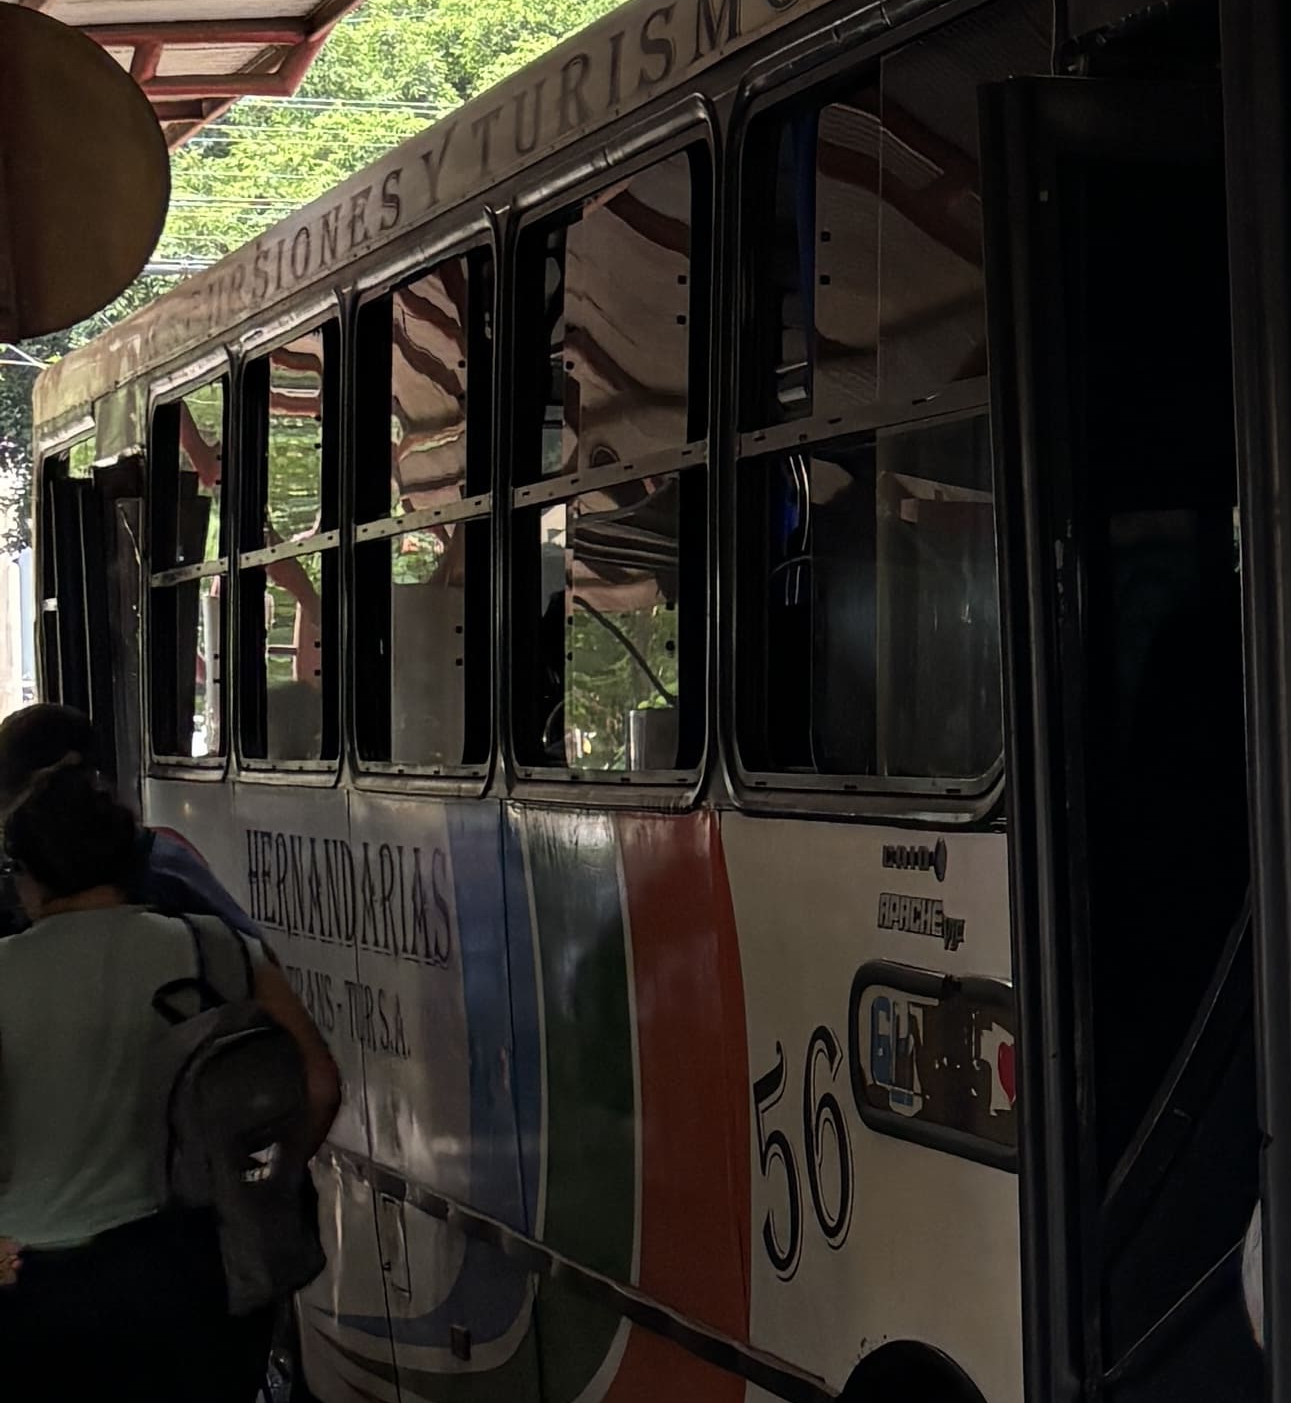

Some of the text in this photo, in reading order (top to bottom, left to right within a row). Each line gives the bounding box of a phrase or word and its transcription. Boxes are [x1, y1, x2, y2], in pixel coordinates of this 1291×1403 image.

[422, 123, 459, 206] Y
[246, 829, 452, 965] HERNANDARIAS
[878, 892, 945, 938] APACHE
[752, 1025, 855, 1282] 56
